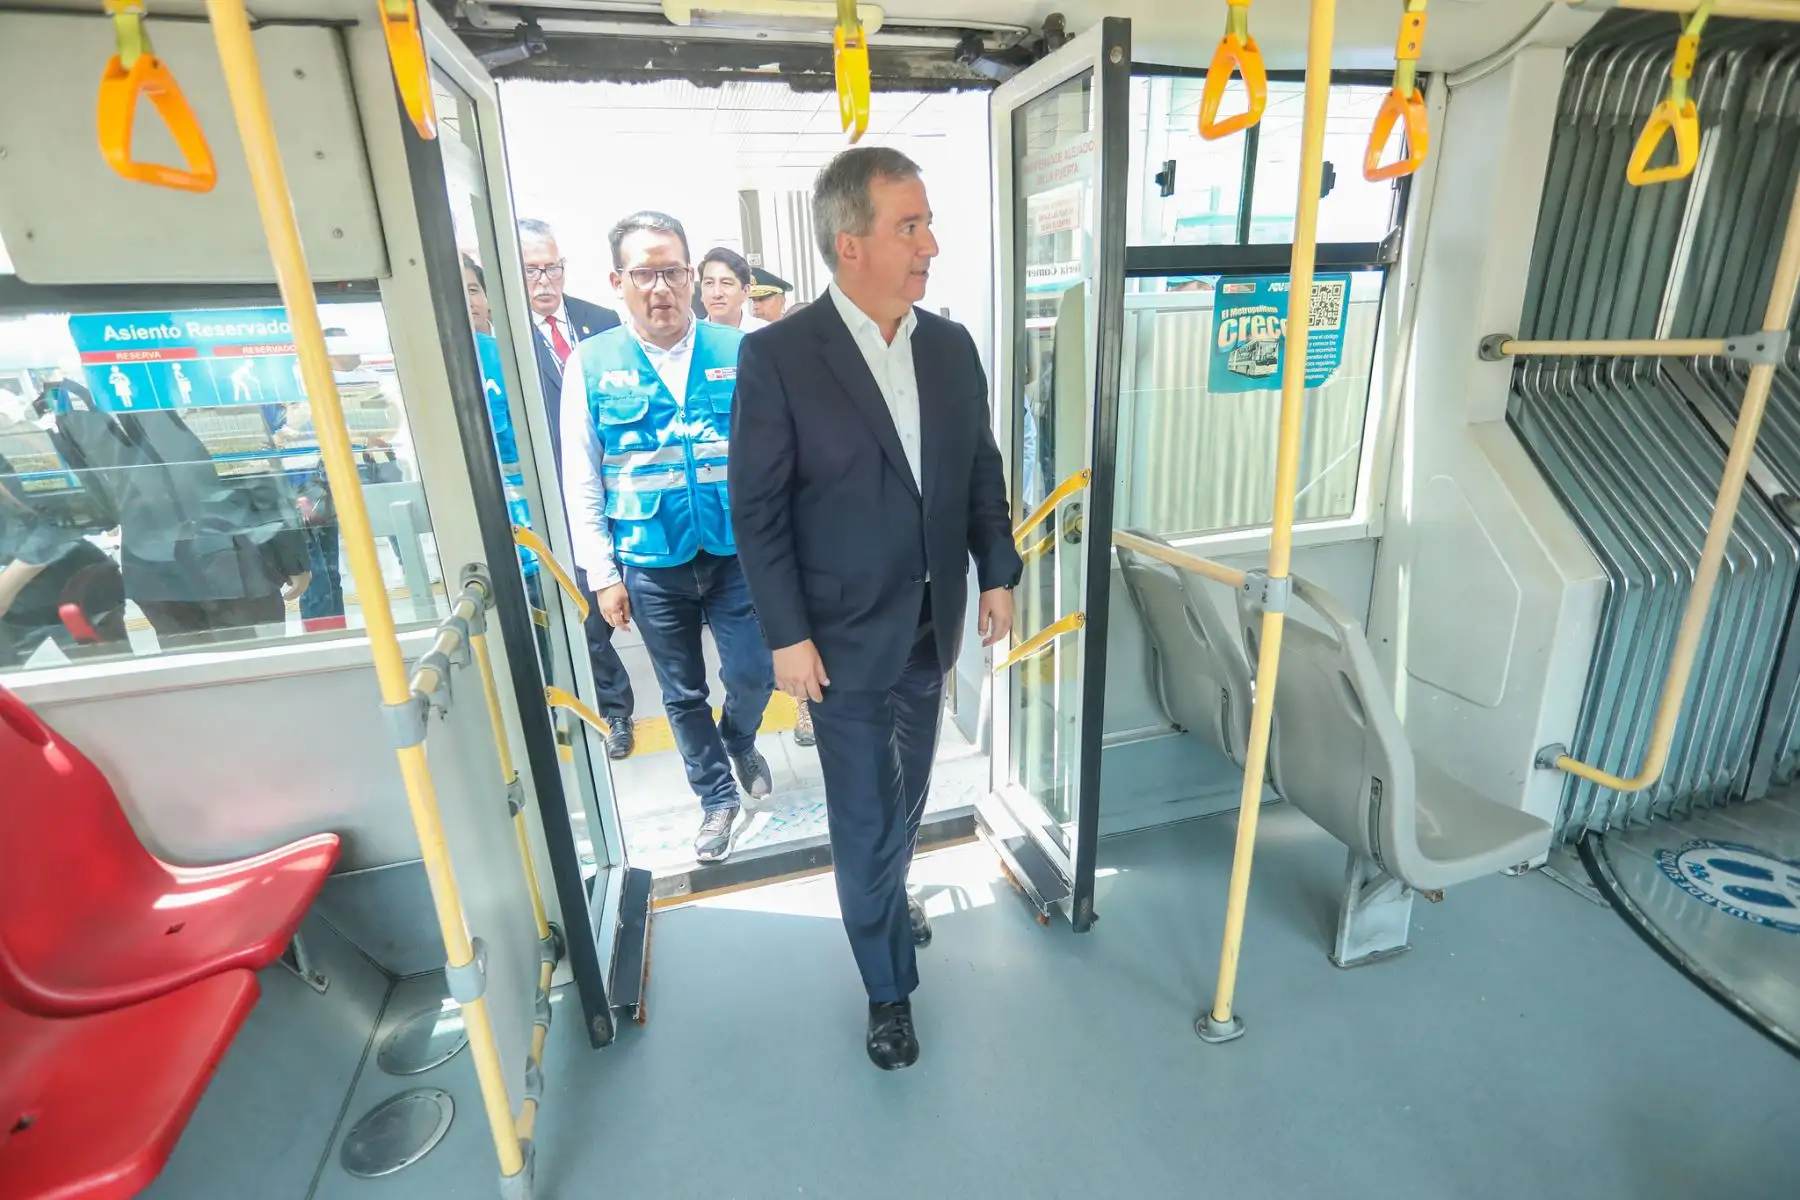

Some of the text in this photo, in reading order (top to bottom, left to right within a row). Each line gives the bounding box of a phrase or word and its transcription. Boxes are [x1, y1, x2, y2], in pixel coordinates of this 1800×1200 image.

[1221, 309, 1229, 320] El
[104, 319, 291, 342] Asiento Reservado
[116, 344, 297, 361] RESERVA RESERVADO
